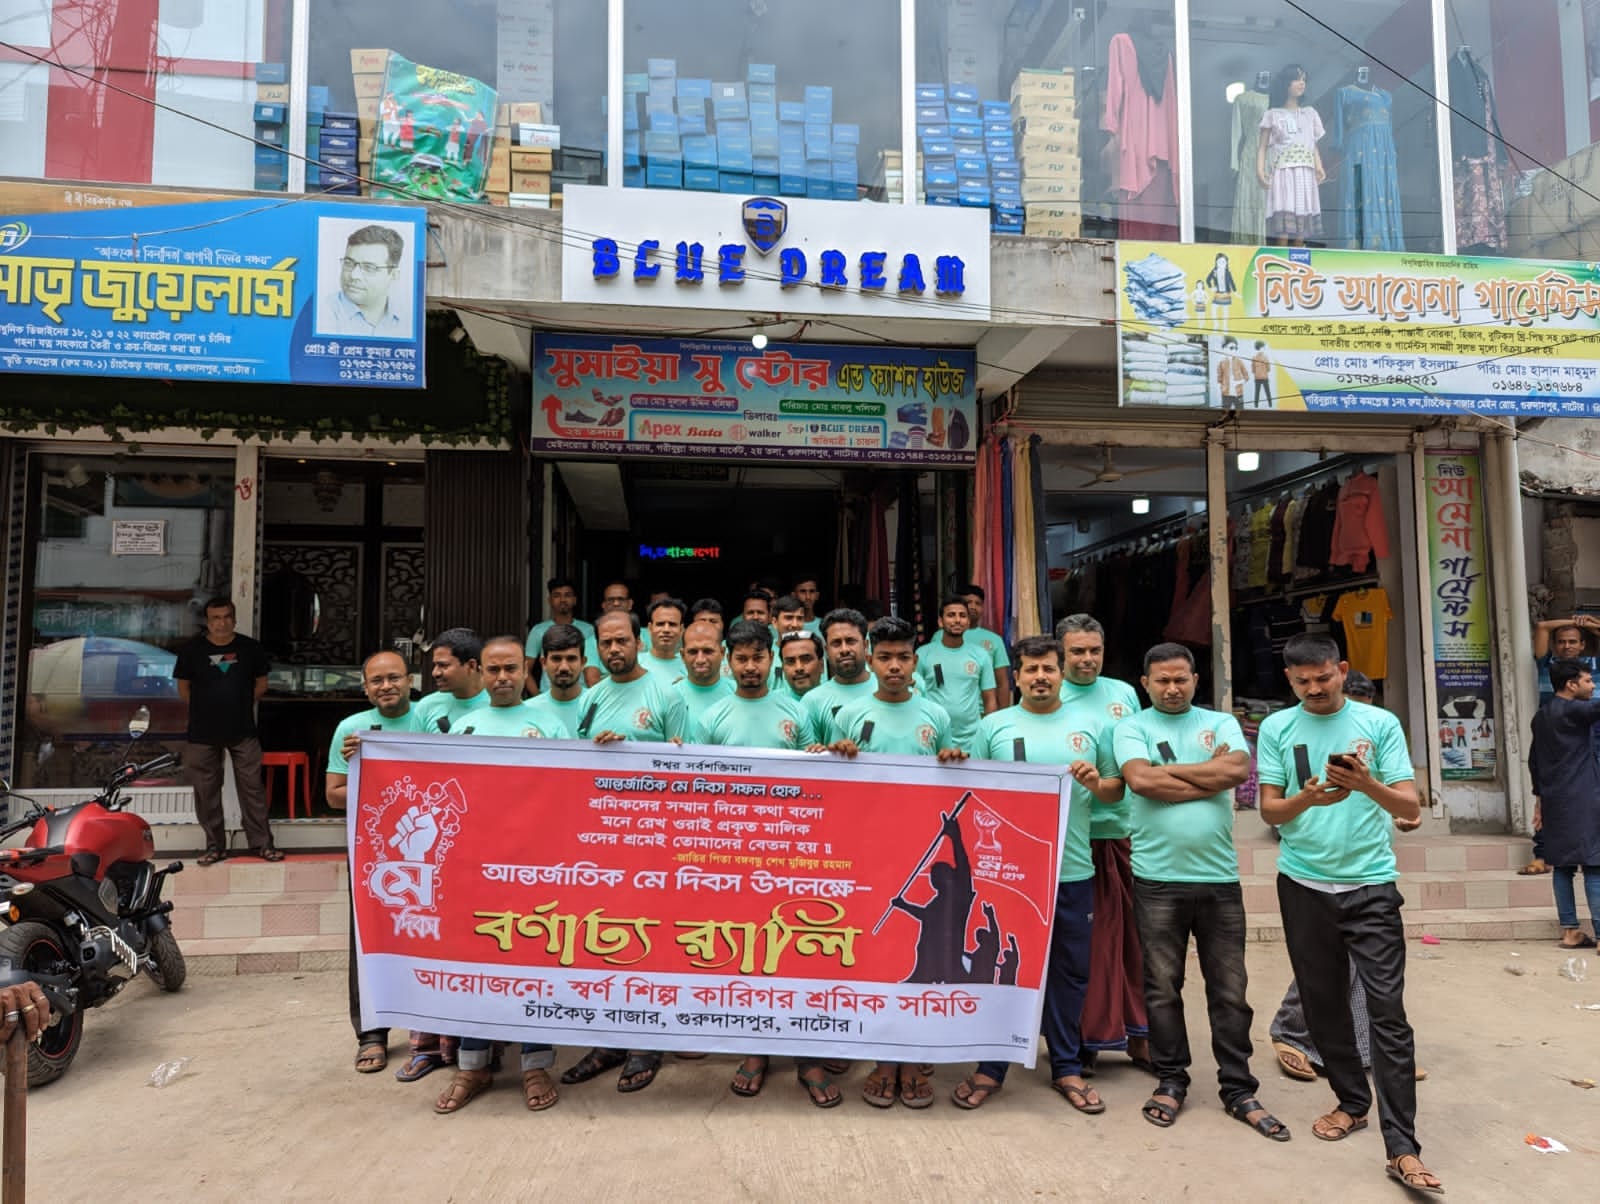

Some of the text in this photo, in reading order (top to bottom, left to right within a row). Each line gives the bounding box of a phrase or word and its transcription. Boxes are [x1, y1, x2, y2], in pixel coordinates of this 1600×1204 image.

[780, 247, 967, 295] DREAM
[81, 257, 298, 323] জুয়েলার্স
[1253, 254, 1327, 316] নিউ
[1333, 272, 1464, 323] আমেনা
[545, 344, 681, 389] সুমাইয়া
[691, 354, 727, 393] সু
[735, 350, 831, 392] ষ্টোর
[868, 361, 919, 398] ফ্যাশন
[921, 356, 967, 401] হাউজ
[1344, 357, 1368, 369] মোঃ
[1418, 356, 1459, 370] ইসলাম
[1505, 365, 1527, 376] মোঃ
[1530, 365, 1561, 377] হাসান
[639, 420, 682, 438] Apex
[687, 427, 723, 438] Bata
[749, 429, 781, 438] walker
[652, 759, 752, 776] ঈশ্বর সর্বশক্তিমান
[594, 775, 668, 794] আন্তর্জাতিক
[671, 780, 689, 795] মে
[692, 778, 726, 797] দিবস
[730, 783, 767, 799] সফল
[588, 794, 825, 820] শ্রমিকদের সম্মান দিয়ে কথা বলো
[600, 814, 811, 838] মনে রেখ ওরাই প্রকৃত মালিক
[577, 832, 618, 846] ওদের
[622, 833, 666, 848] শ্রমেই
[672, 837, 744, 852] তোমাদের
[748, 841, 790, 854] বেতন
[709, 853, 731, 866] পিতা
[766, 857, 786, 868] শেখ
[822, 860, 854, 871] রহমান
[366, 861, 438, 908] মে
[481, 861, 626, 887] আন্তর্জাতিক
[633, 868, 669, 891] মে
[674, 866, 742, 893] দিবস
[567, 975, 618, 1002] স্বর্ণ
[622, 977, 681, 1006] শিল্প
[690, 981, 797, 1010] কারিগর
[805, 985, 889, 1014] শ্রমিক
[896, 990, 982, 1017] সমিতি
[602, 1008, 667, 1029] বাজার,
[676, 1010, 782, 1034] গুরুদাসপুর,
